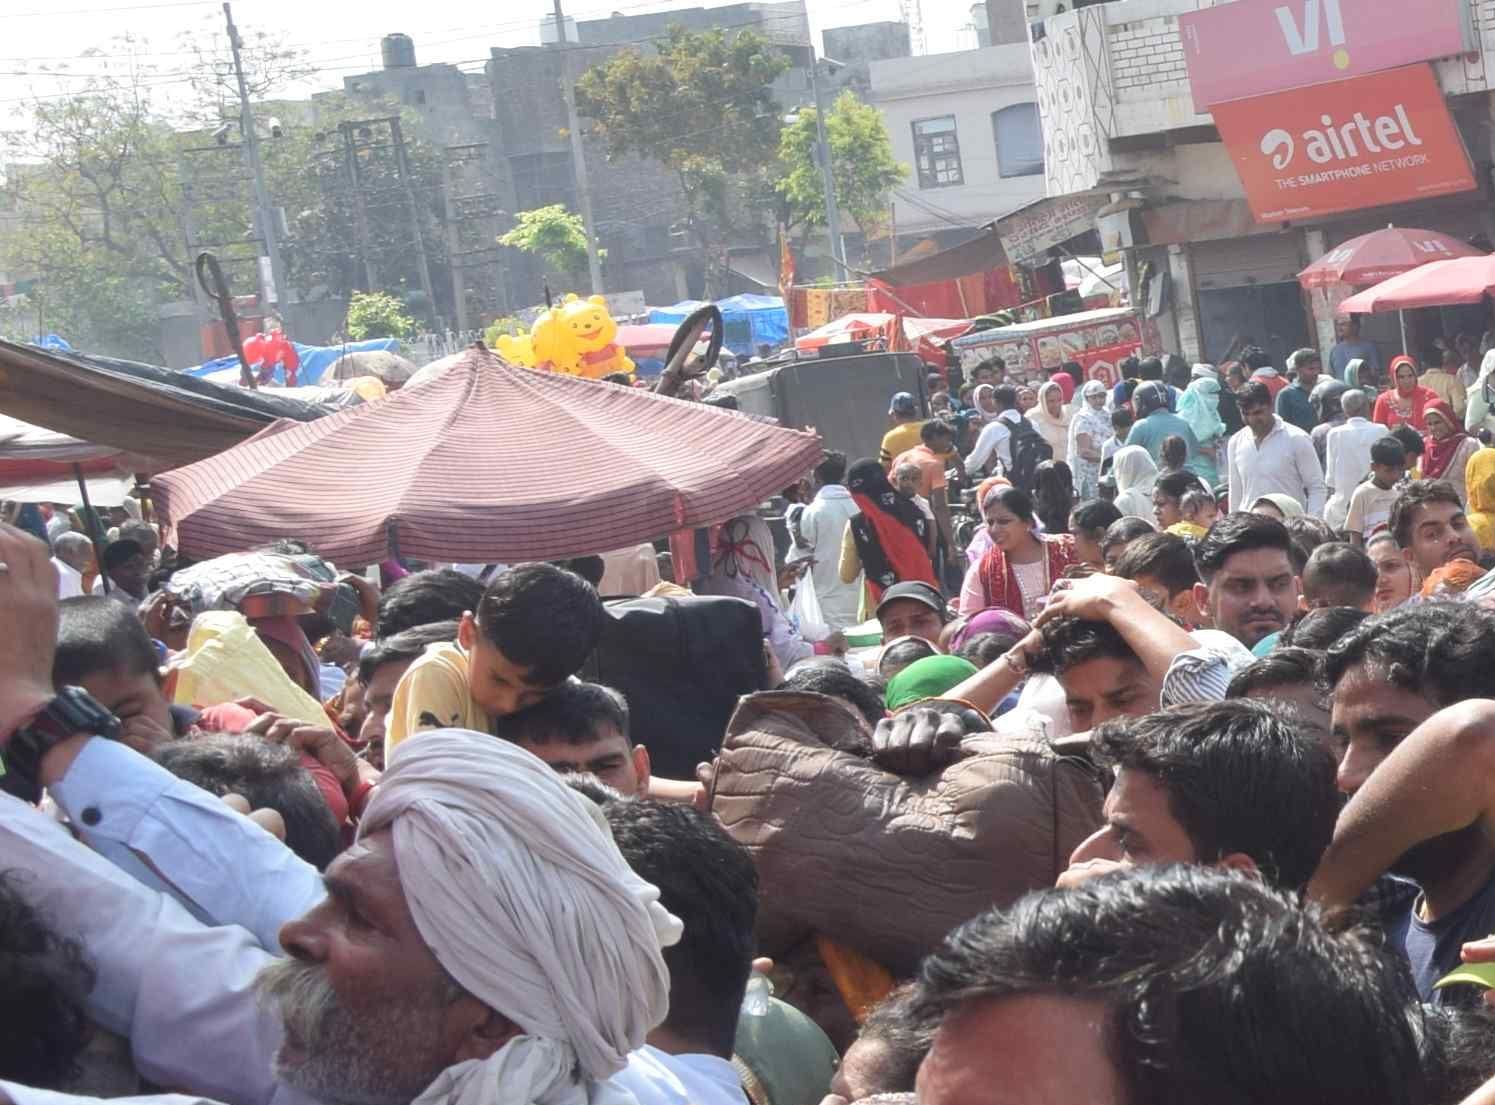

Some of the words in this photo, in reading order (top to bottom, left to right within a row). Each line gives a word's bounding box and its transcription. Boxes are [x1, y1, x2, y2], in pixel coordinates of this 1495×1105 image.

[1302, 104, 1423, 164] airtel
[1275, 177, 1298, 190] THE
[1299, 164, 1372, 186] SMARTPHONE
[1374, 153, 1431, 174] NETWORK
